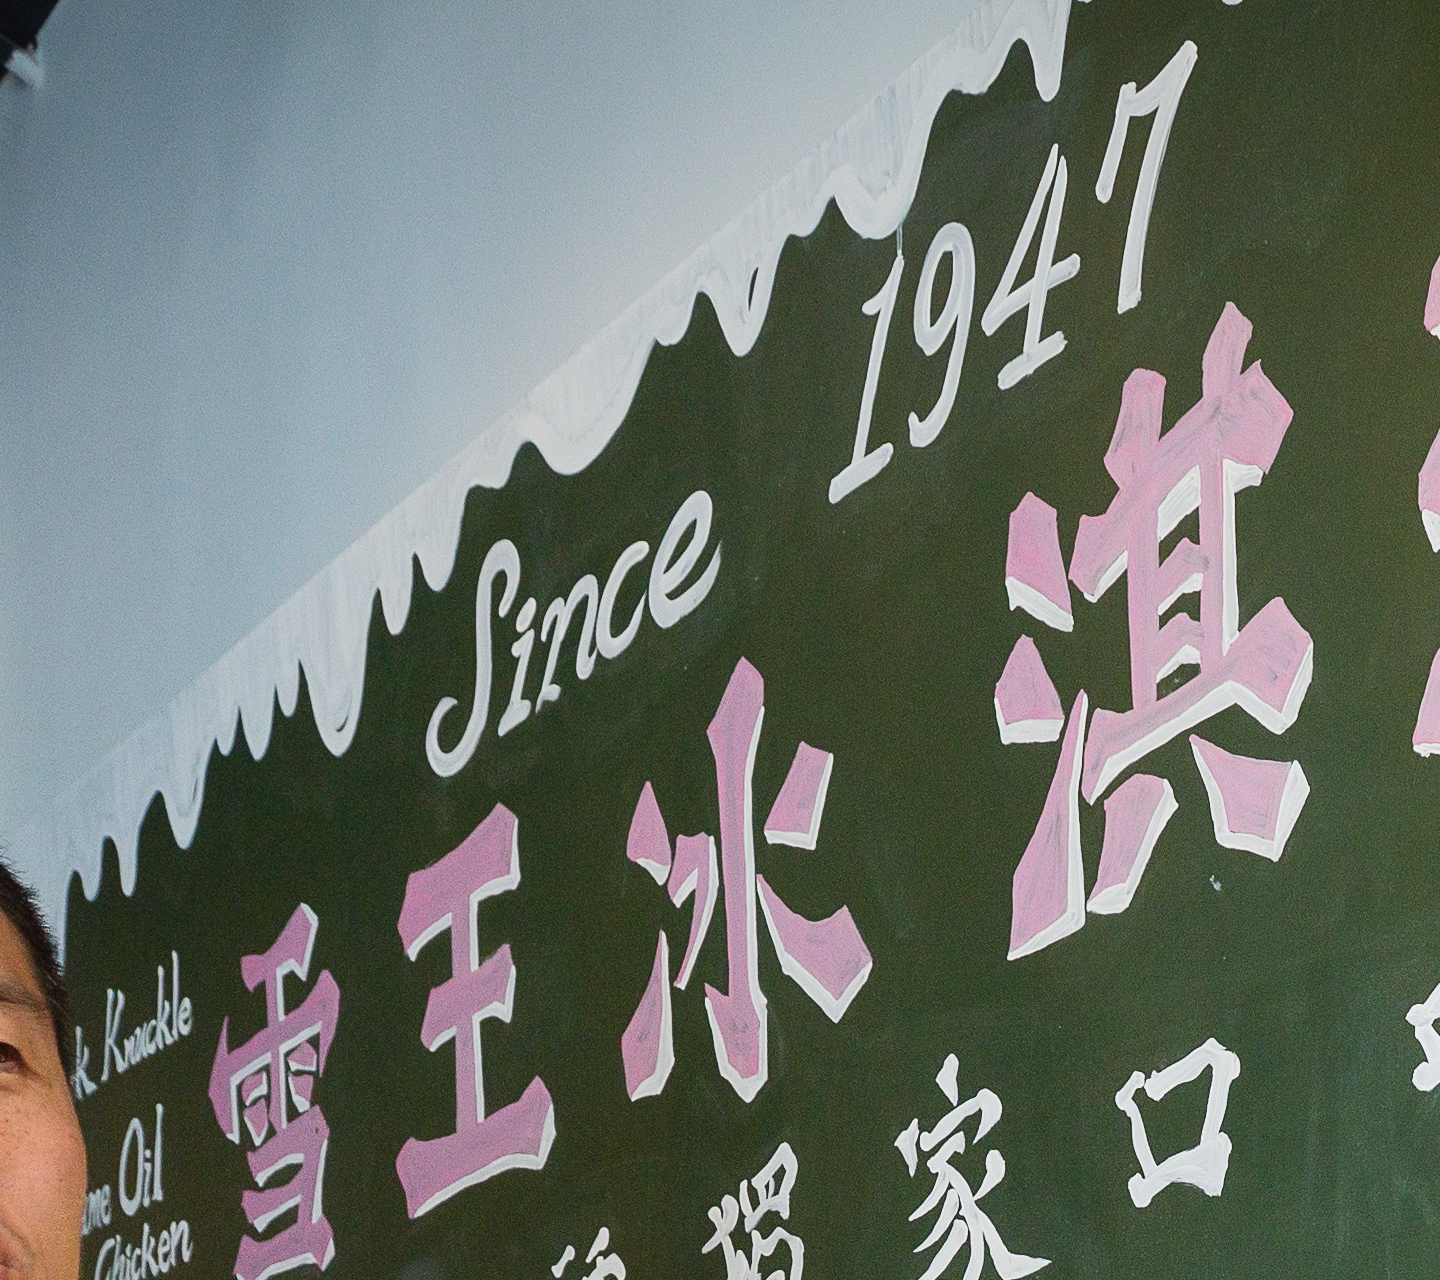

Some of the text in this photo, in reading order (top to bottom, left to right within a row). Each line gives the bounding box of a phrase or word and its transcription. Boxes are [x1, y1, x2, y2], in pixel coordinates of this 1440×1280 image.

[426, 40, 1197, 778] Since 1947
[101, 950, 193, 1082] Knuckle
[118, 1103, 164, 1217] Oil
